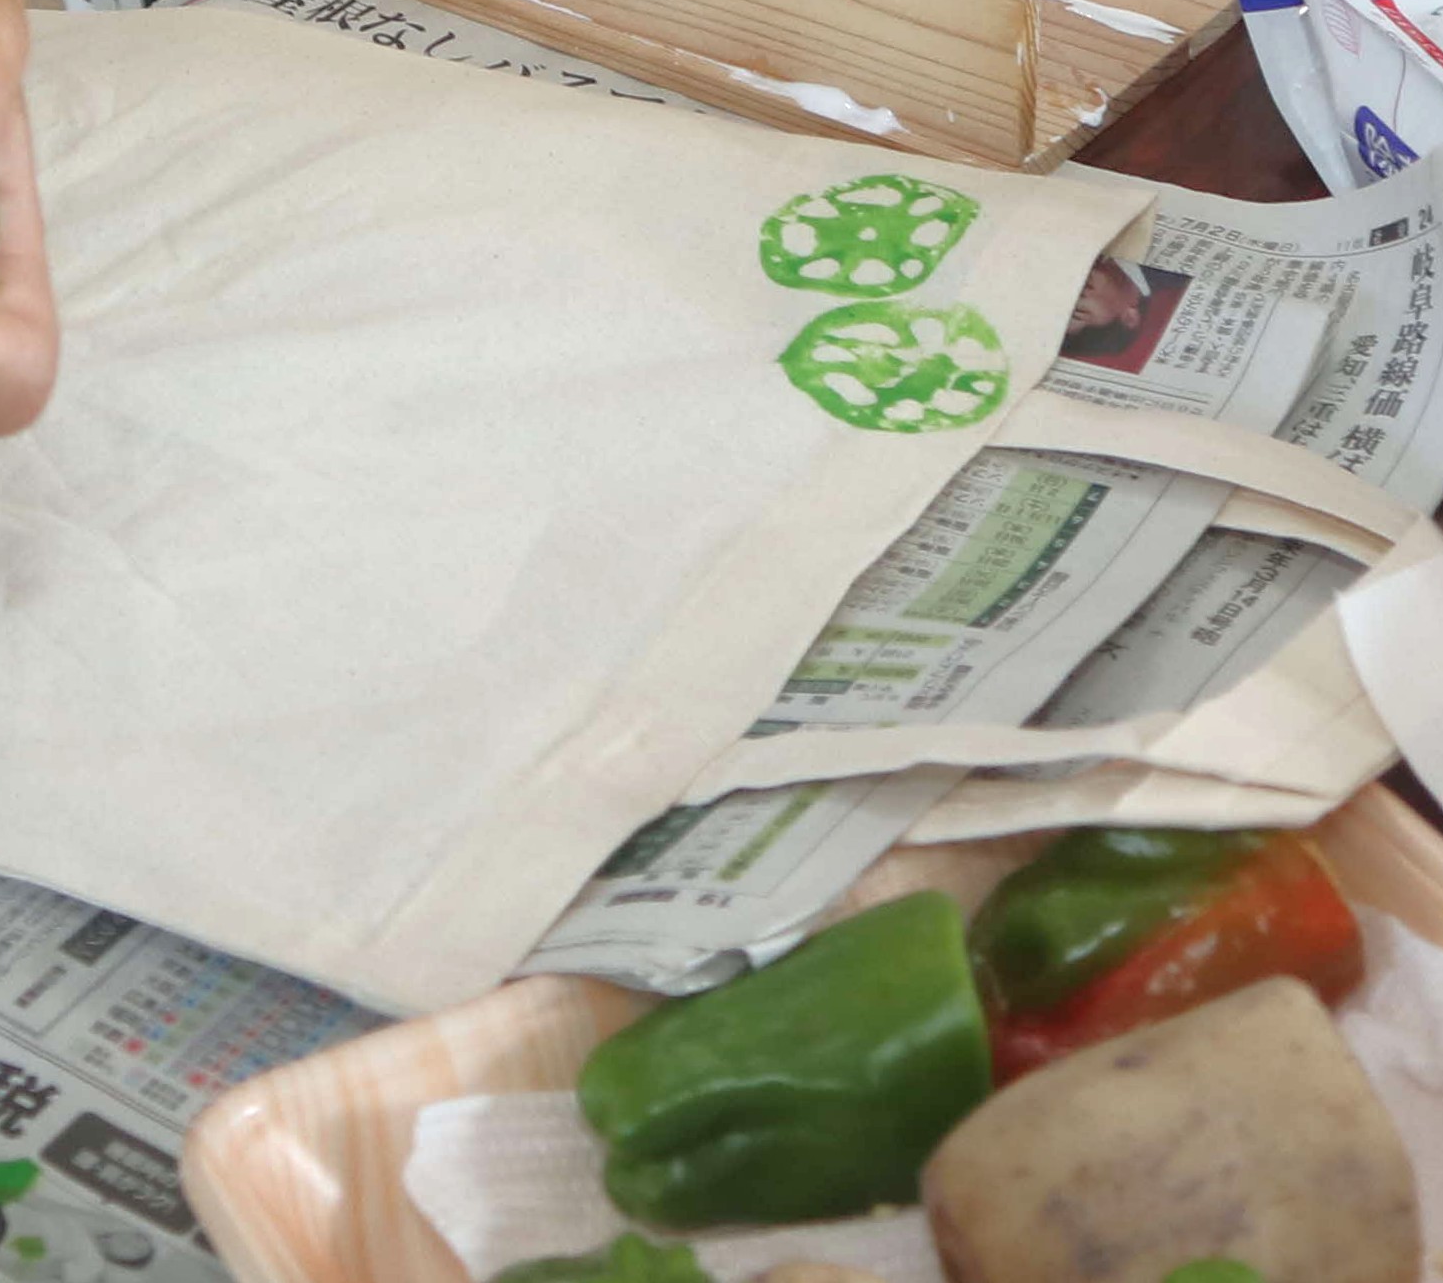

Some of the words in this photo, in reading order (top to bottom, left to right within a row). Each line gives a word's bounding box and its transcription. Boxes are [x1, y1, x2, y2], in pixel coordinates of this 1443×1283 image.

[1364, 242, 1438, 419] 岐阜路線価
